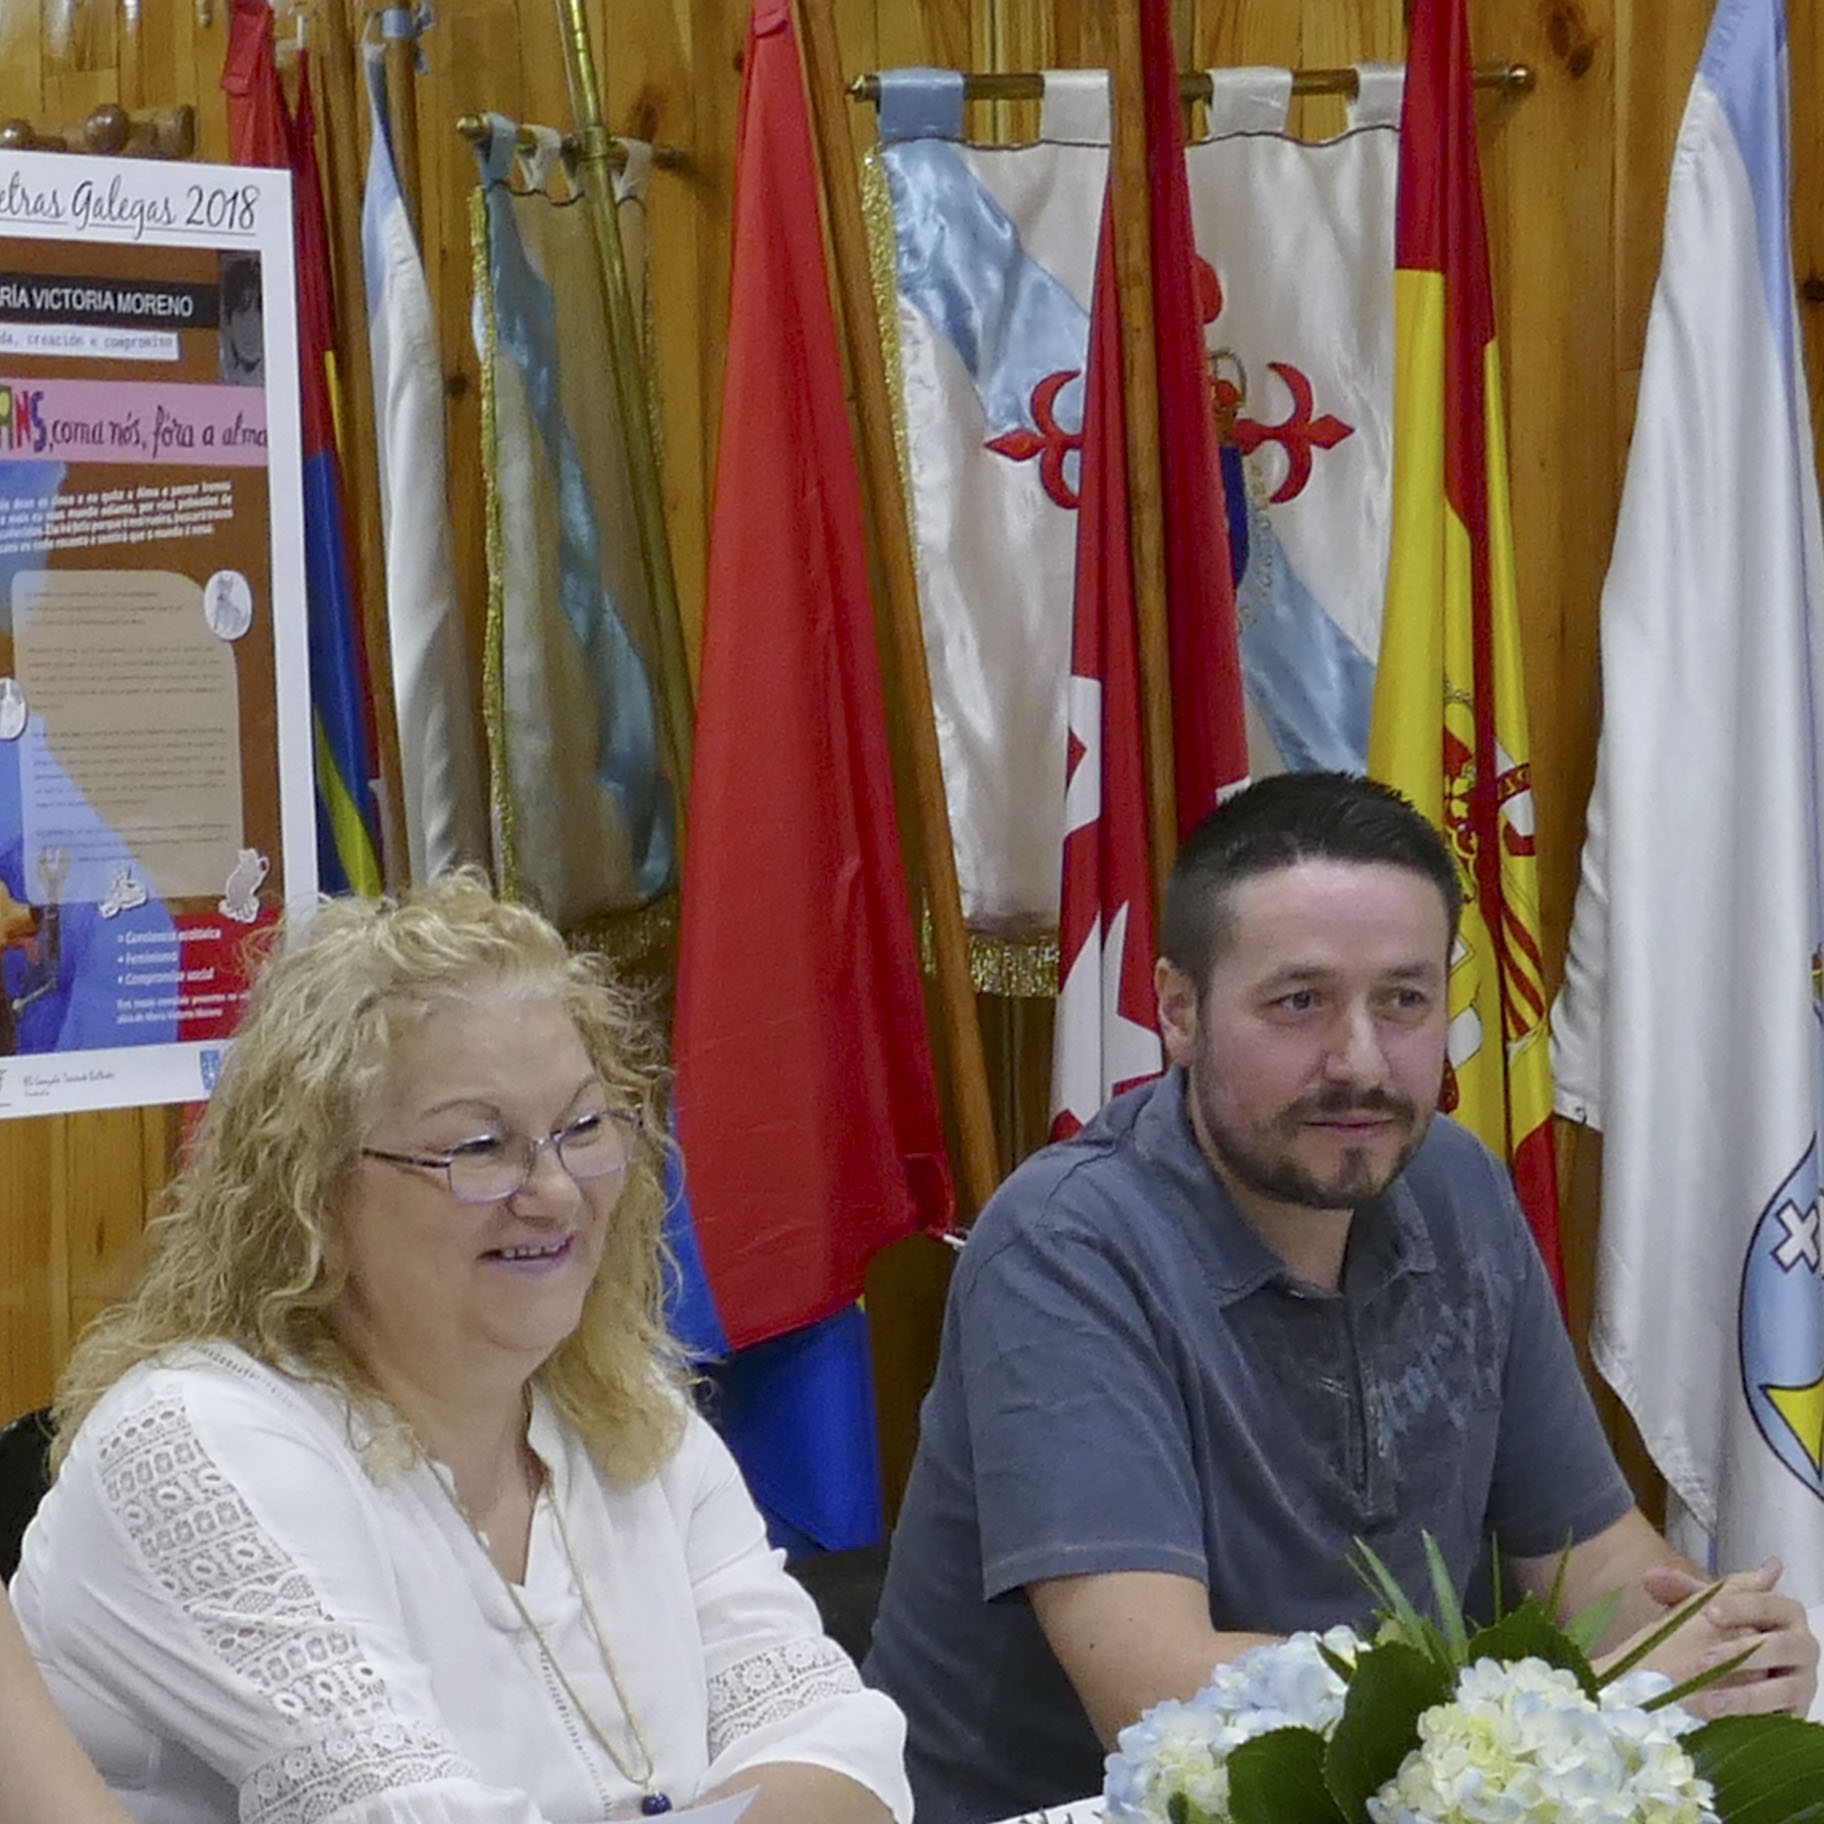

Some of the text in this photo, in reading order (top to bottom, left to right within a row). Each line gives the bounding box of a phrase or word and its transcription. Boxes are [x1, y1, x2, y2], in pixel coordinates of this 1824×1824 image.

[72, 174, 177, 240] Galegas
[186, 184, 261, 231] 2018
[32, 286, 116, 313] VICTORIA
[117, 293, 194, 317] MORENO
[201, 426, 214, 446] a
[221, 412, 268, 447] alma
